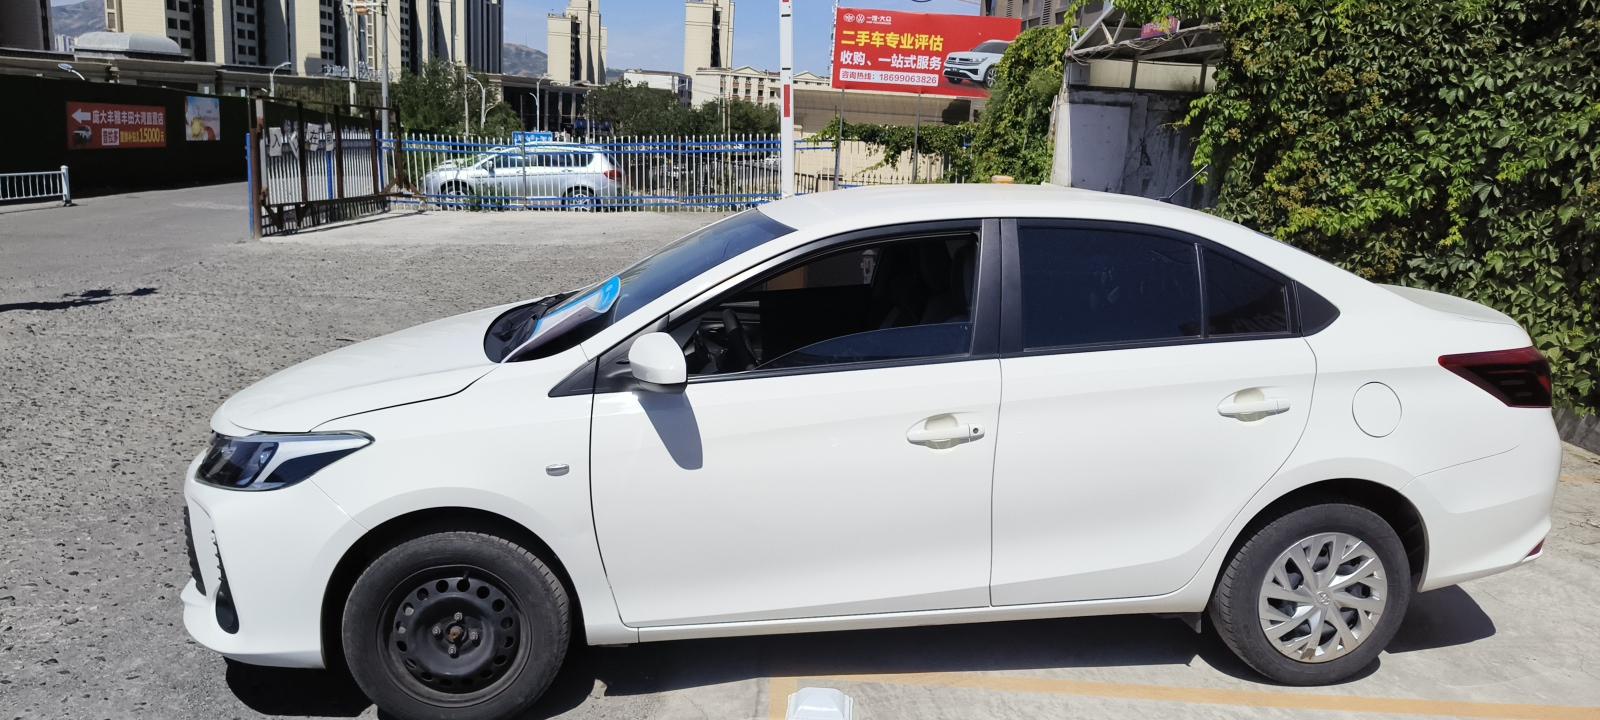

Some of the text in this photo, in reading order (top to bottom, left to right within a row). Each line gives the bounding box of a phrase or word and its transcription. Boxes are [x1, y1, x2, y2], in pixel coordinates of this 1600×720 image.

[841, 30, 943, 51] 二手车专业评估
[840, 50, 942, 70] 收购、一站式服务
